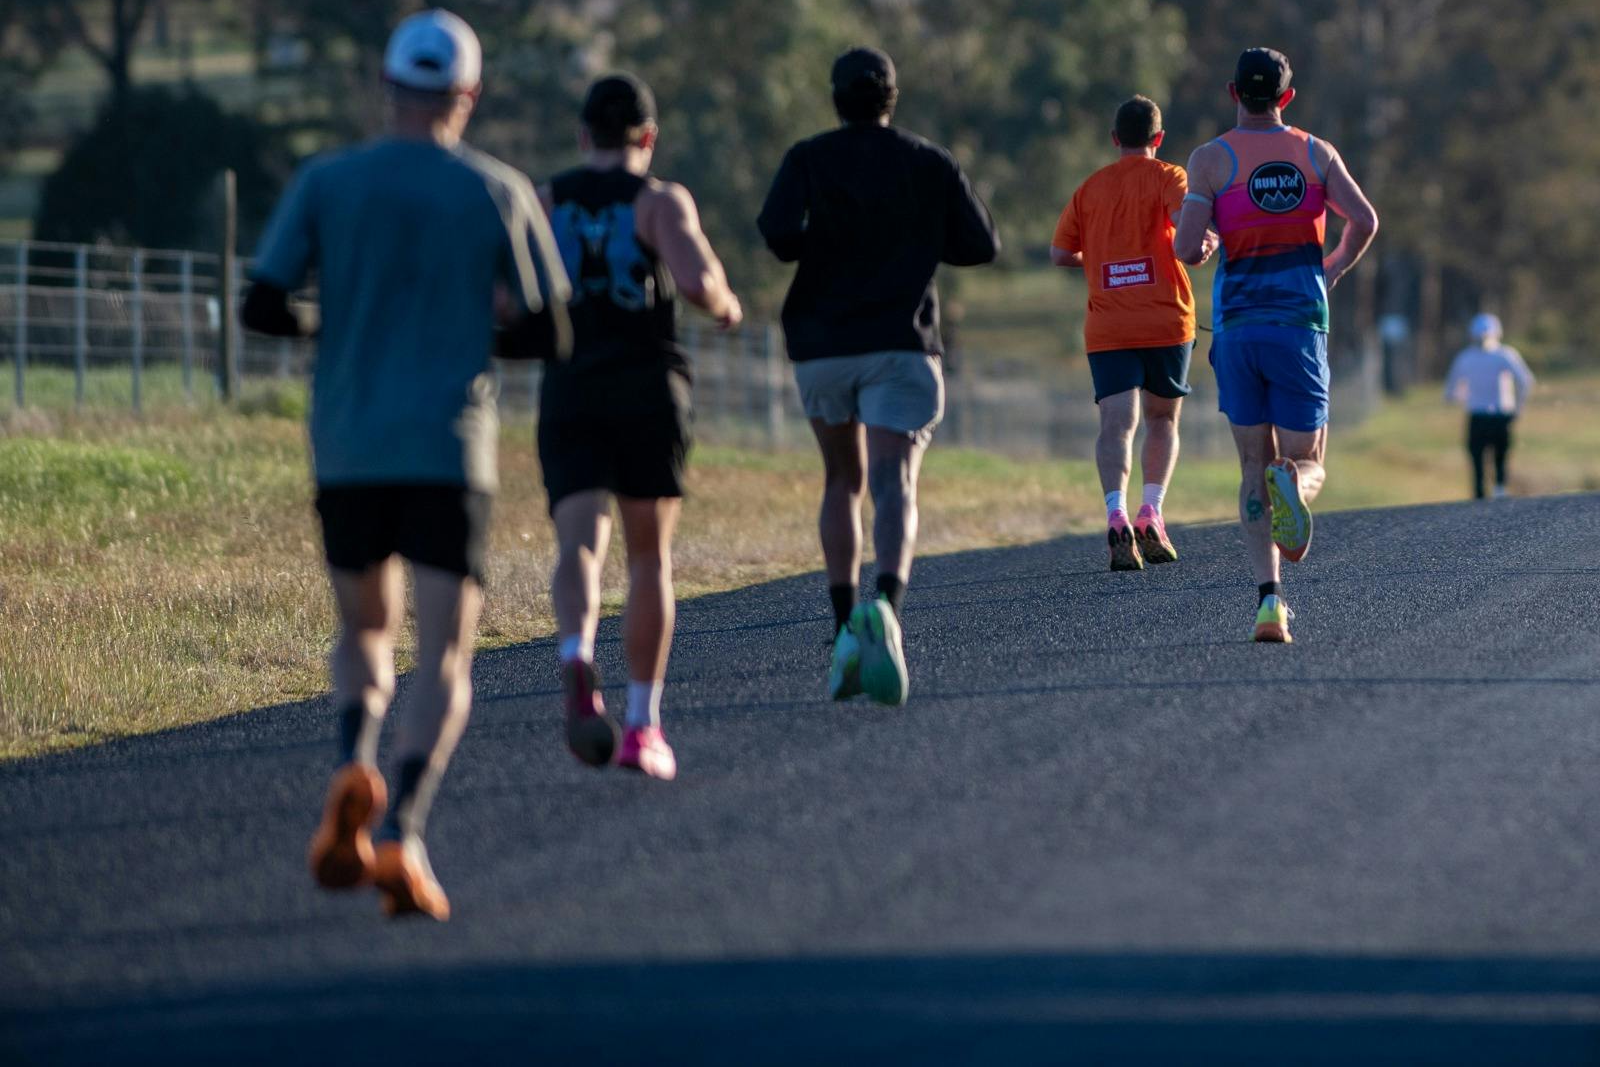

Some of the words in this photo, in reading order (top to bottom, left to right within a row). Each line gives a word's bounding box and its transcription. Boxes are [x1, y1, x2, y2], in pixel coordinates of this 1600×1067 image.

[1254, 176, 1277, 189] RUN
[1109, 262, 1146, 275] Harvey
[1109, 272, 1149, 286] Norman
